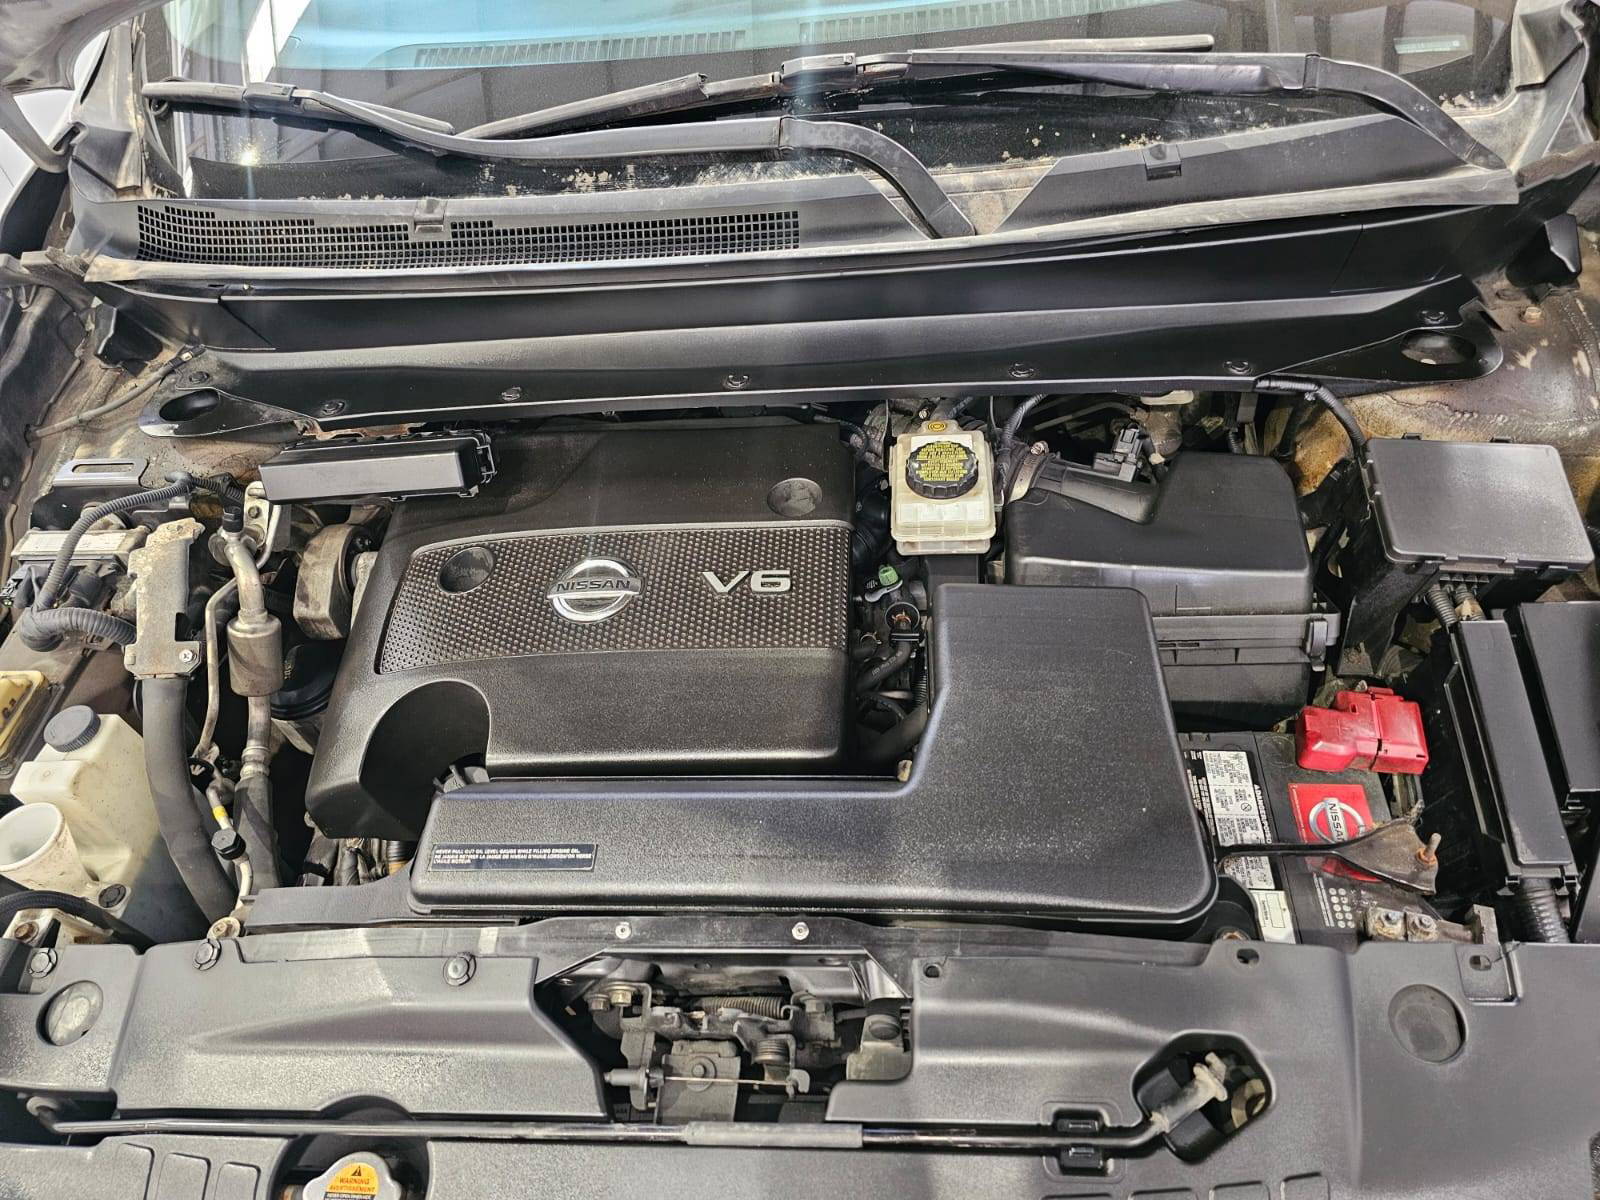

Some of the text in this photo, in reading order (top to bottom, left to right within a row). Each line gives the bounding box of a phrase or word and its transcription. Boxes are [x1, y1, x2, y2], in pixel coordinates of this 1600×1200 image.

[557, 579, 631, 591] NISSAN
[702, 569, 792, 593] V6
[1255, 789, 1272, 844] DANGER/POISO
[339, 1177, 370, 1185] WARNING
